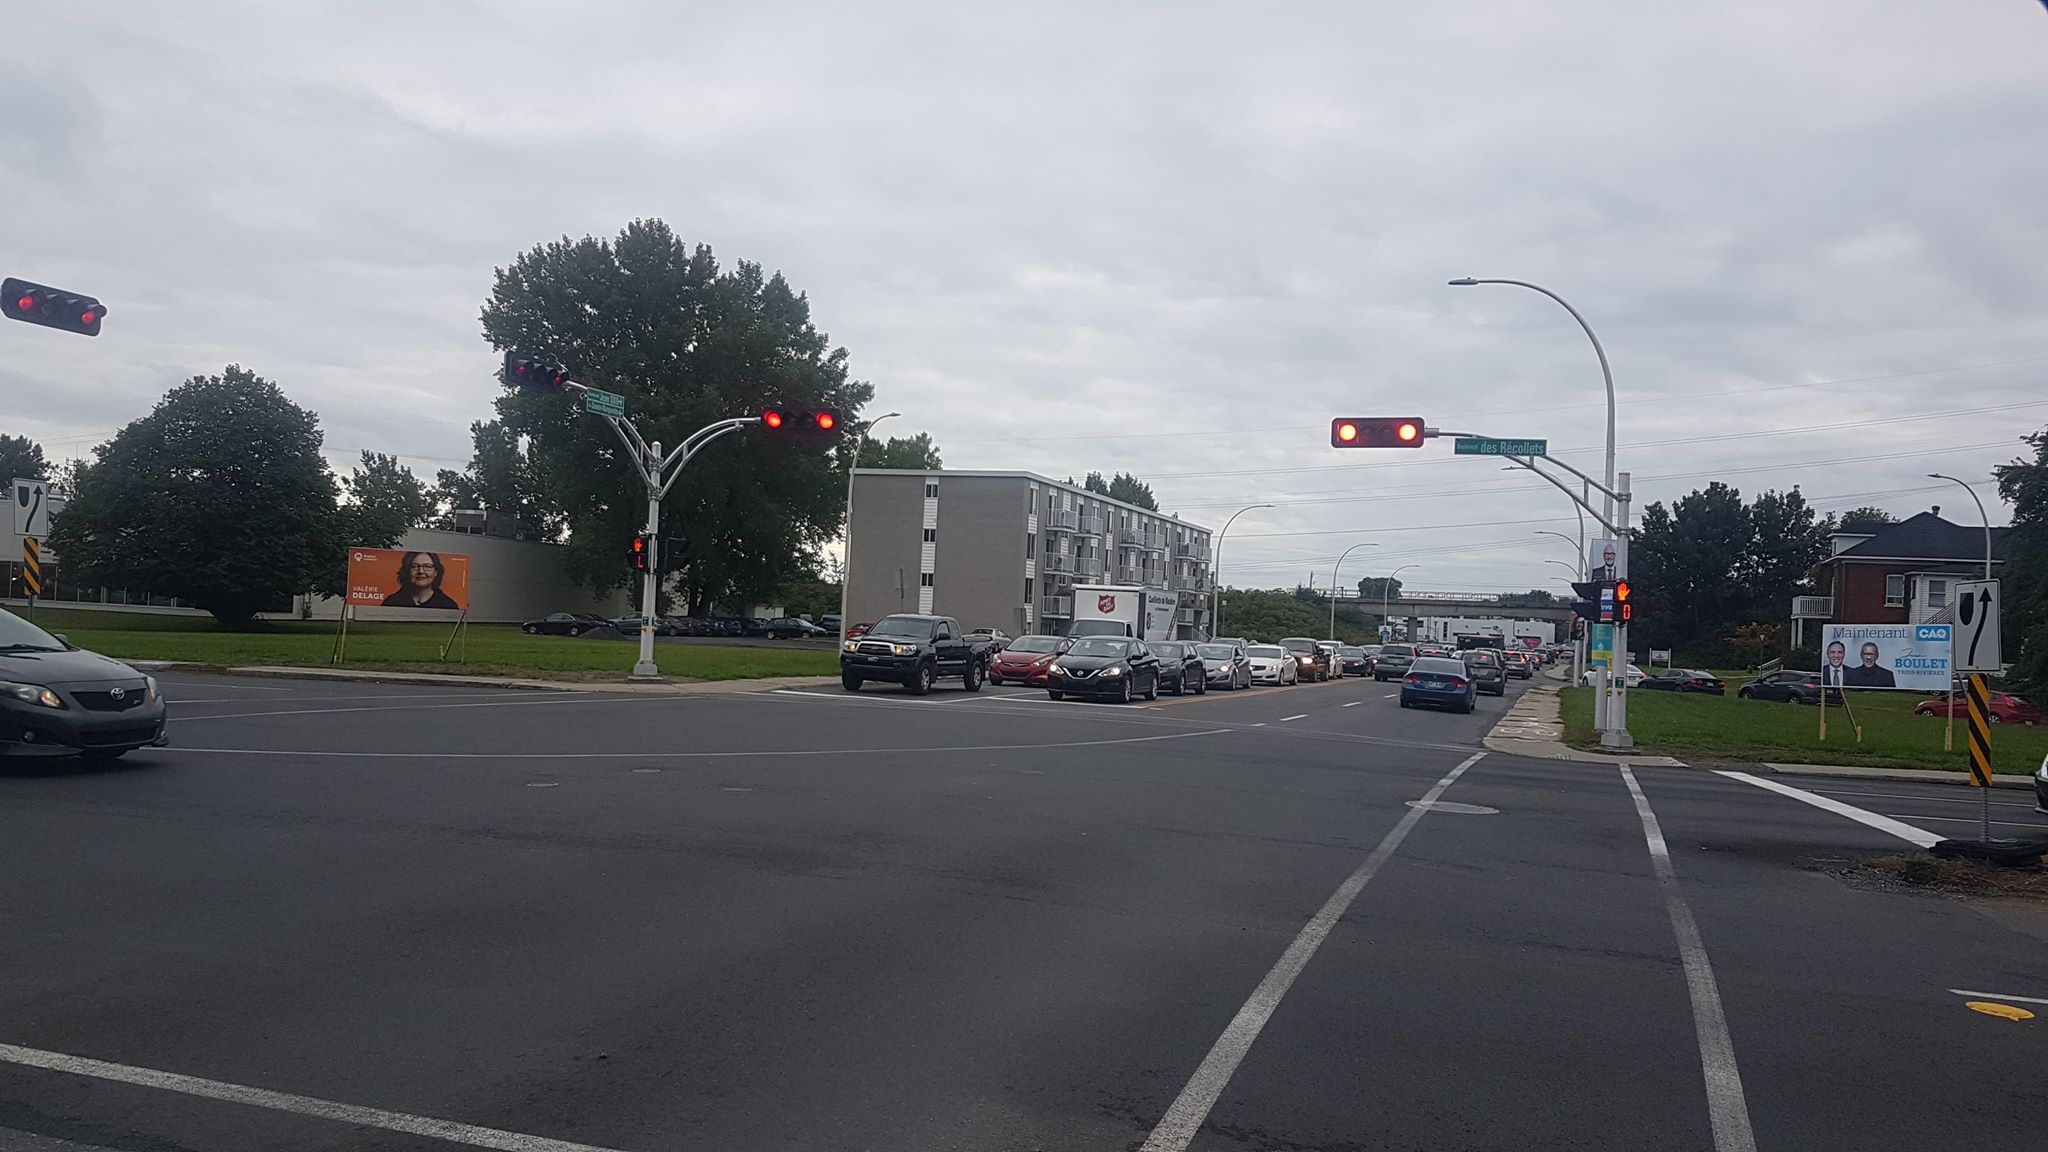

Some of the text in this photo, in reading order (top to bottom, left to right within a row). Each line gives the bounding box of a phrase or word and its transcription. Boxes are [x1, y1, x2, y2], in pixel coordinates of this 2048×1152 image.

[1480, 441, 1497, 454] des
[1499, 441, 1544, 455] Récollets
[352, 592, 385, 600] DELAGE
[1919, 628, 1947, 639] CAQ
[1894, 658, 1948, 669] BOULET
